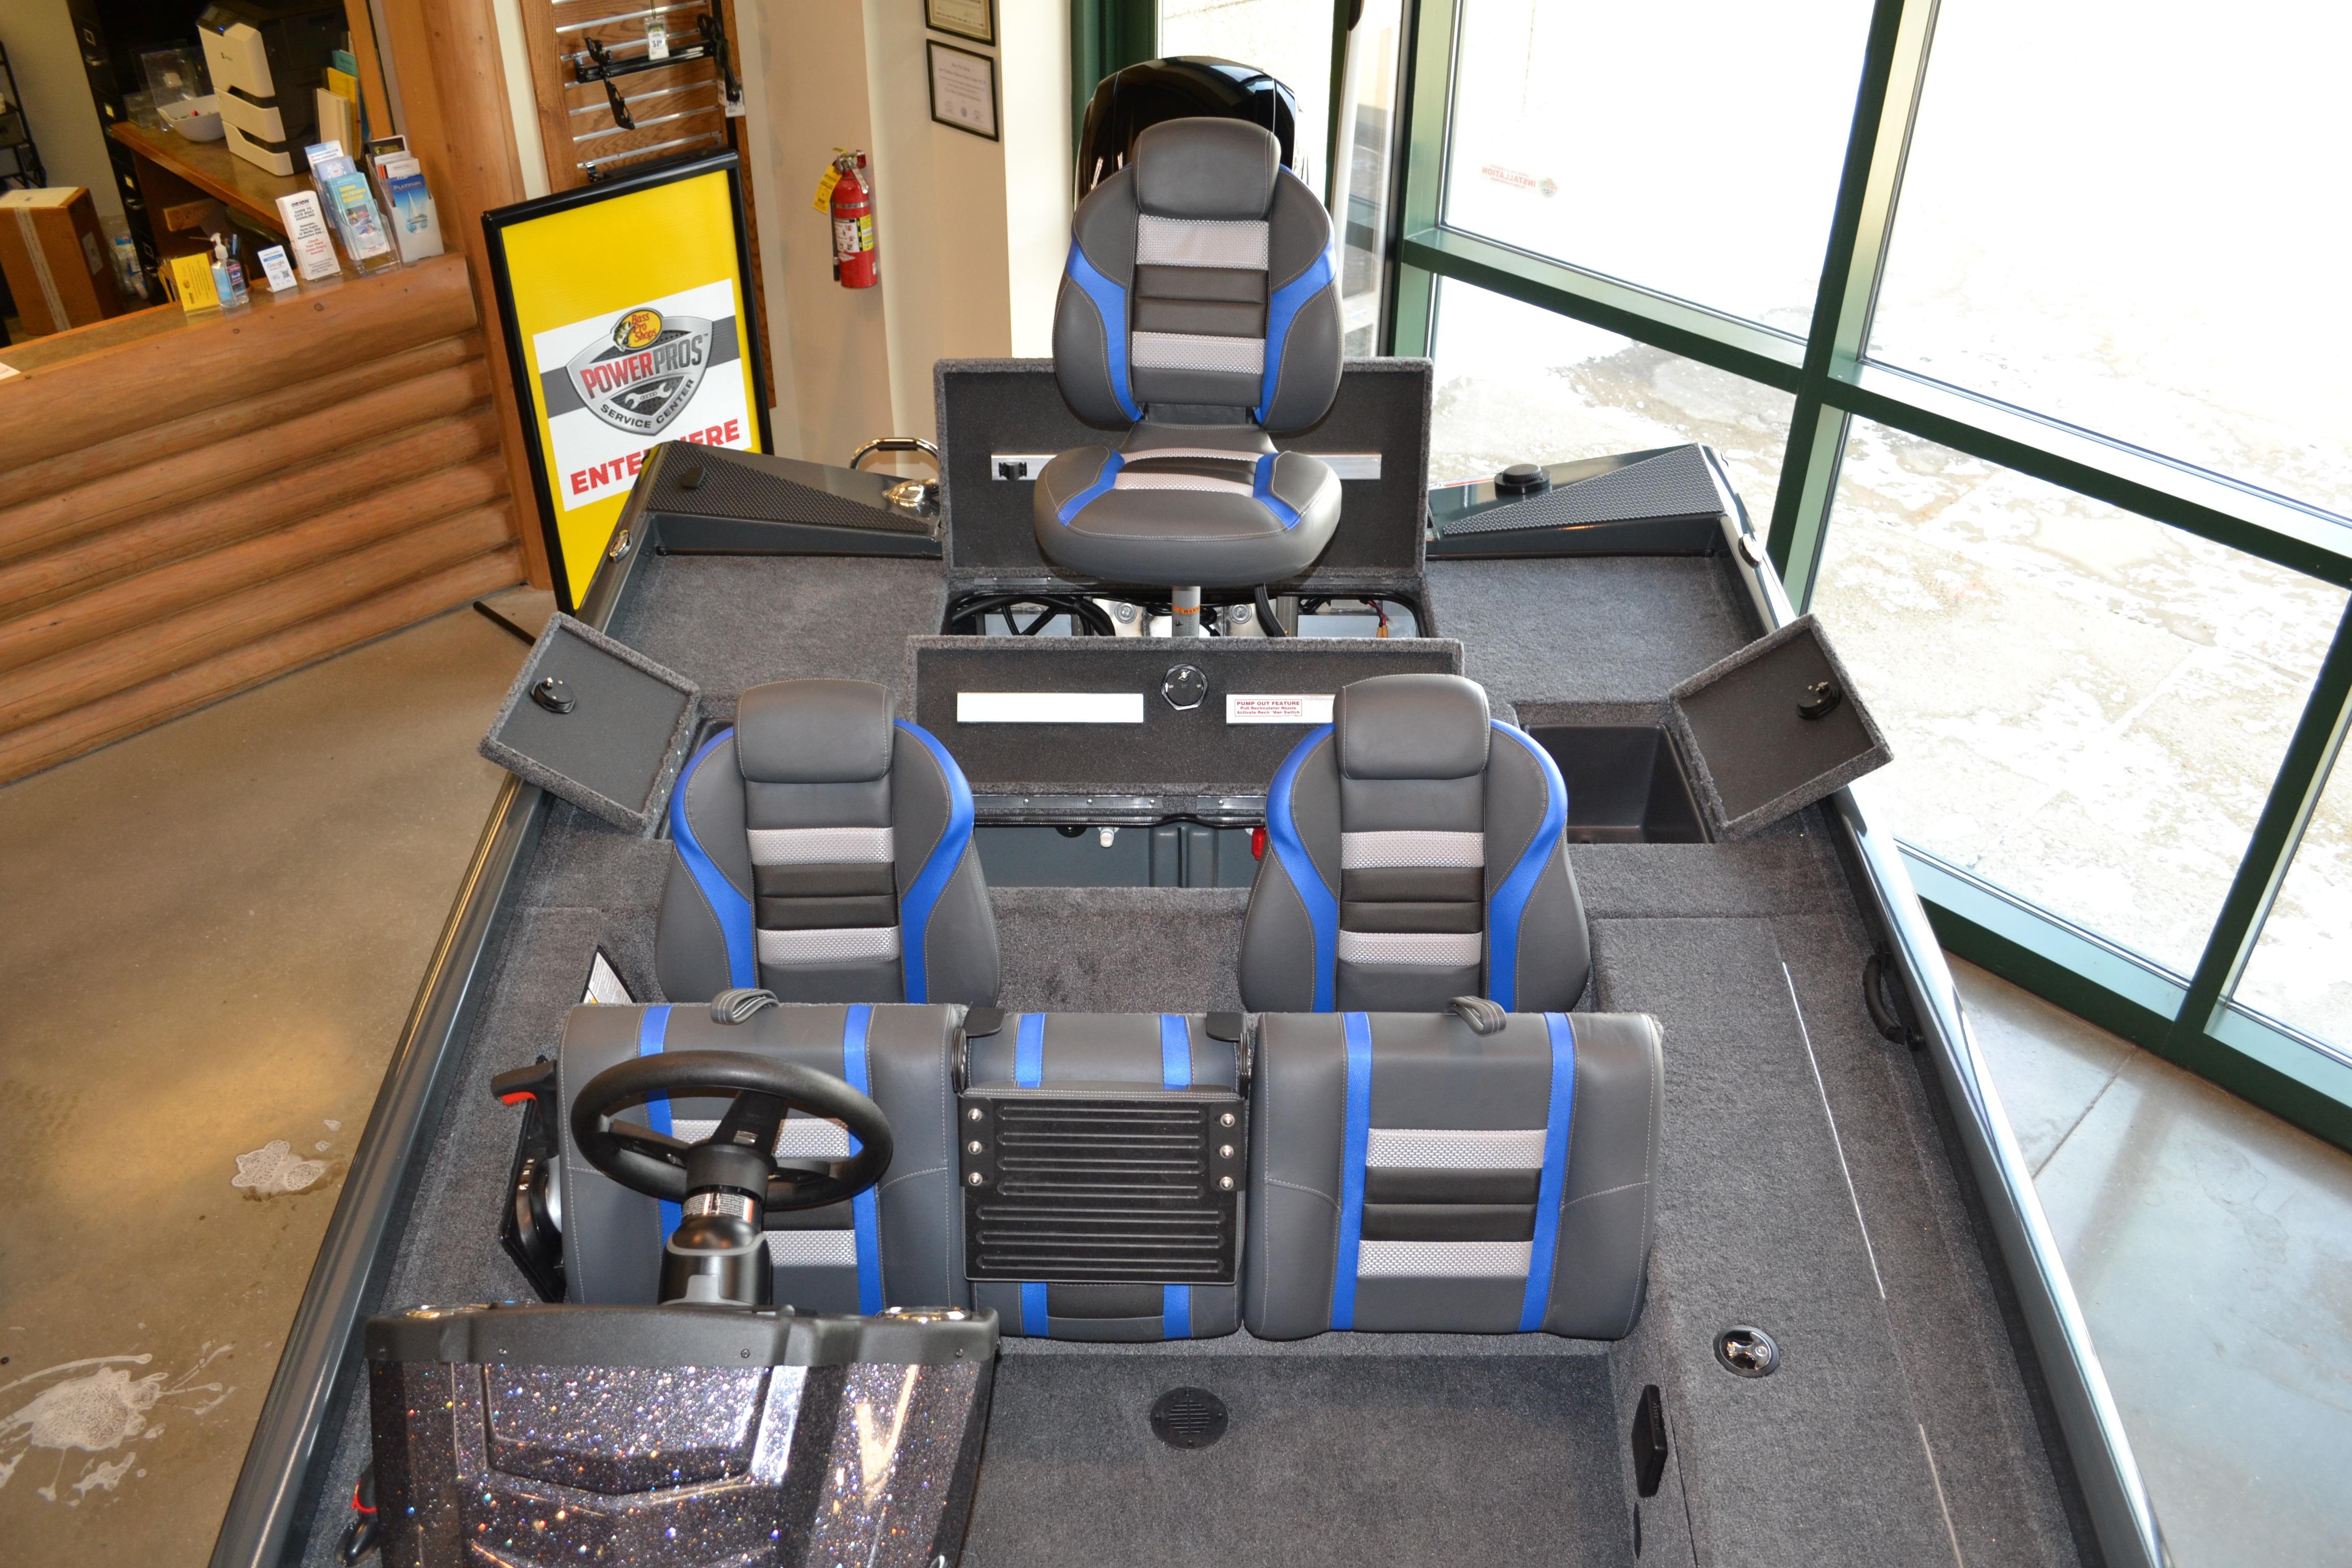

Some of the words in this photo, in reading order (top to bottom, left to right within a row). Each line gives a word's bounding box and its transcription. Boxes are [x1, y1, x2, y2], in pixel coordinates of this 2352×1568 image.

[291, 199, 309, 208] ORION
[631, 313, 650, 325] Bass
[632, 323, 647, 333] Pro
[634, 329, 656, 342] Shops
[601, 404, 651, 428] SERVICE
[656, 379, 694, 424] CENTER
[570, 449, 650, 495] ENTE
[679, 419, 740, 446] ERE
